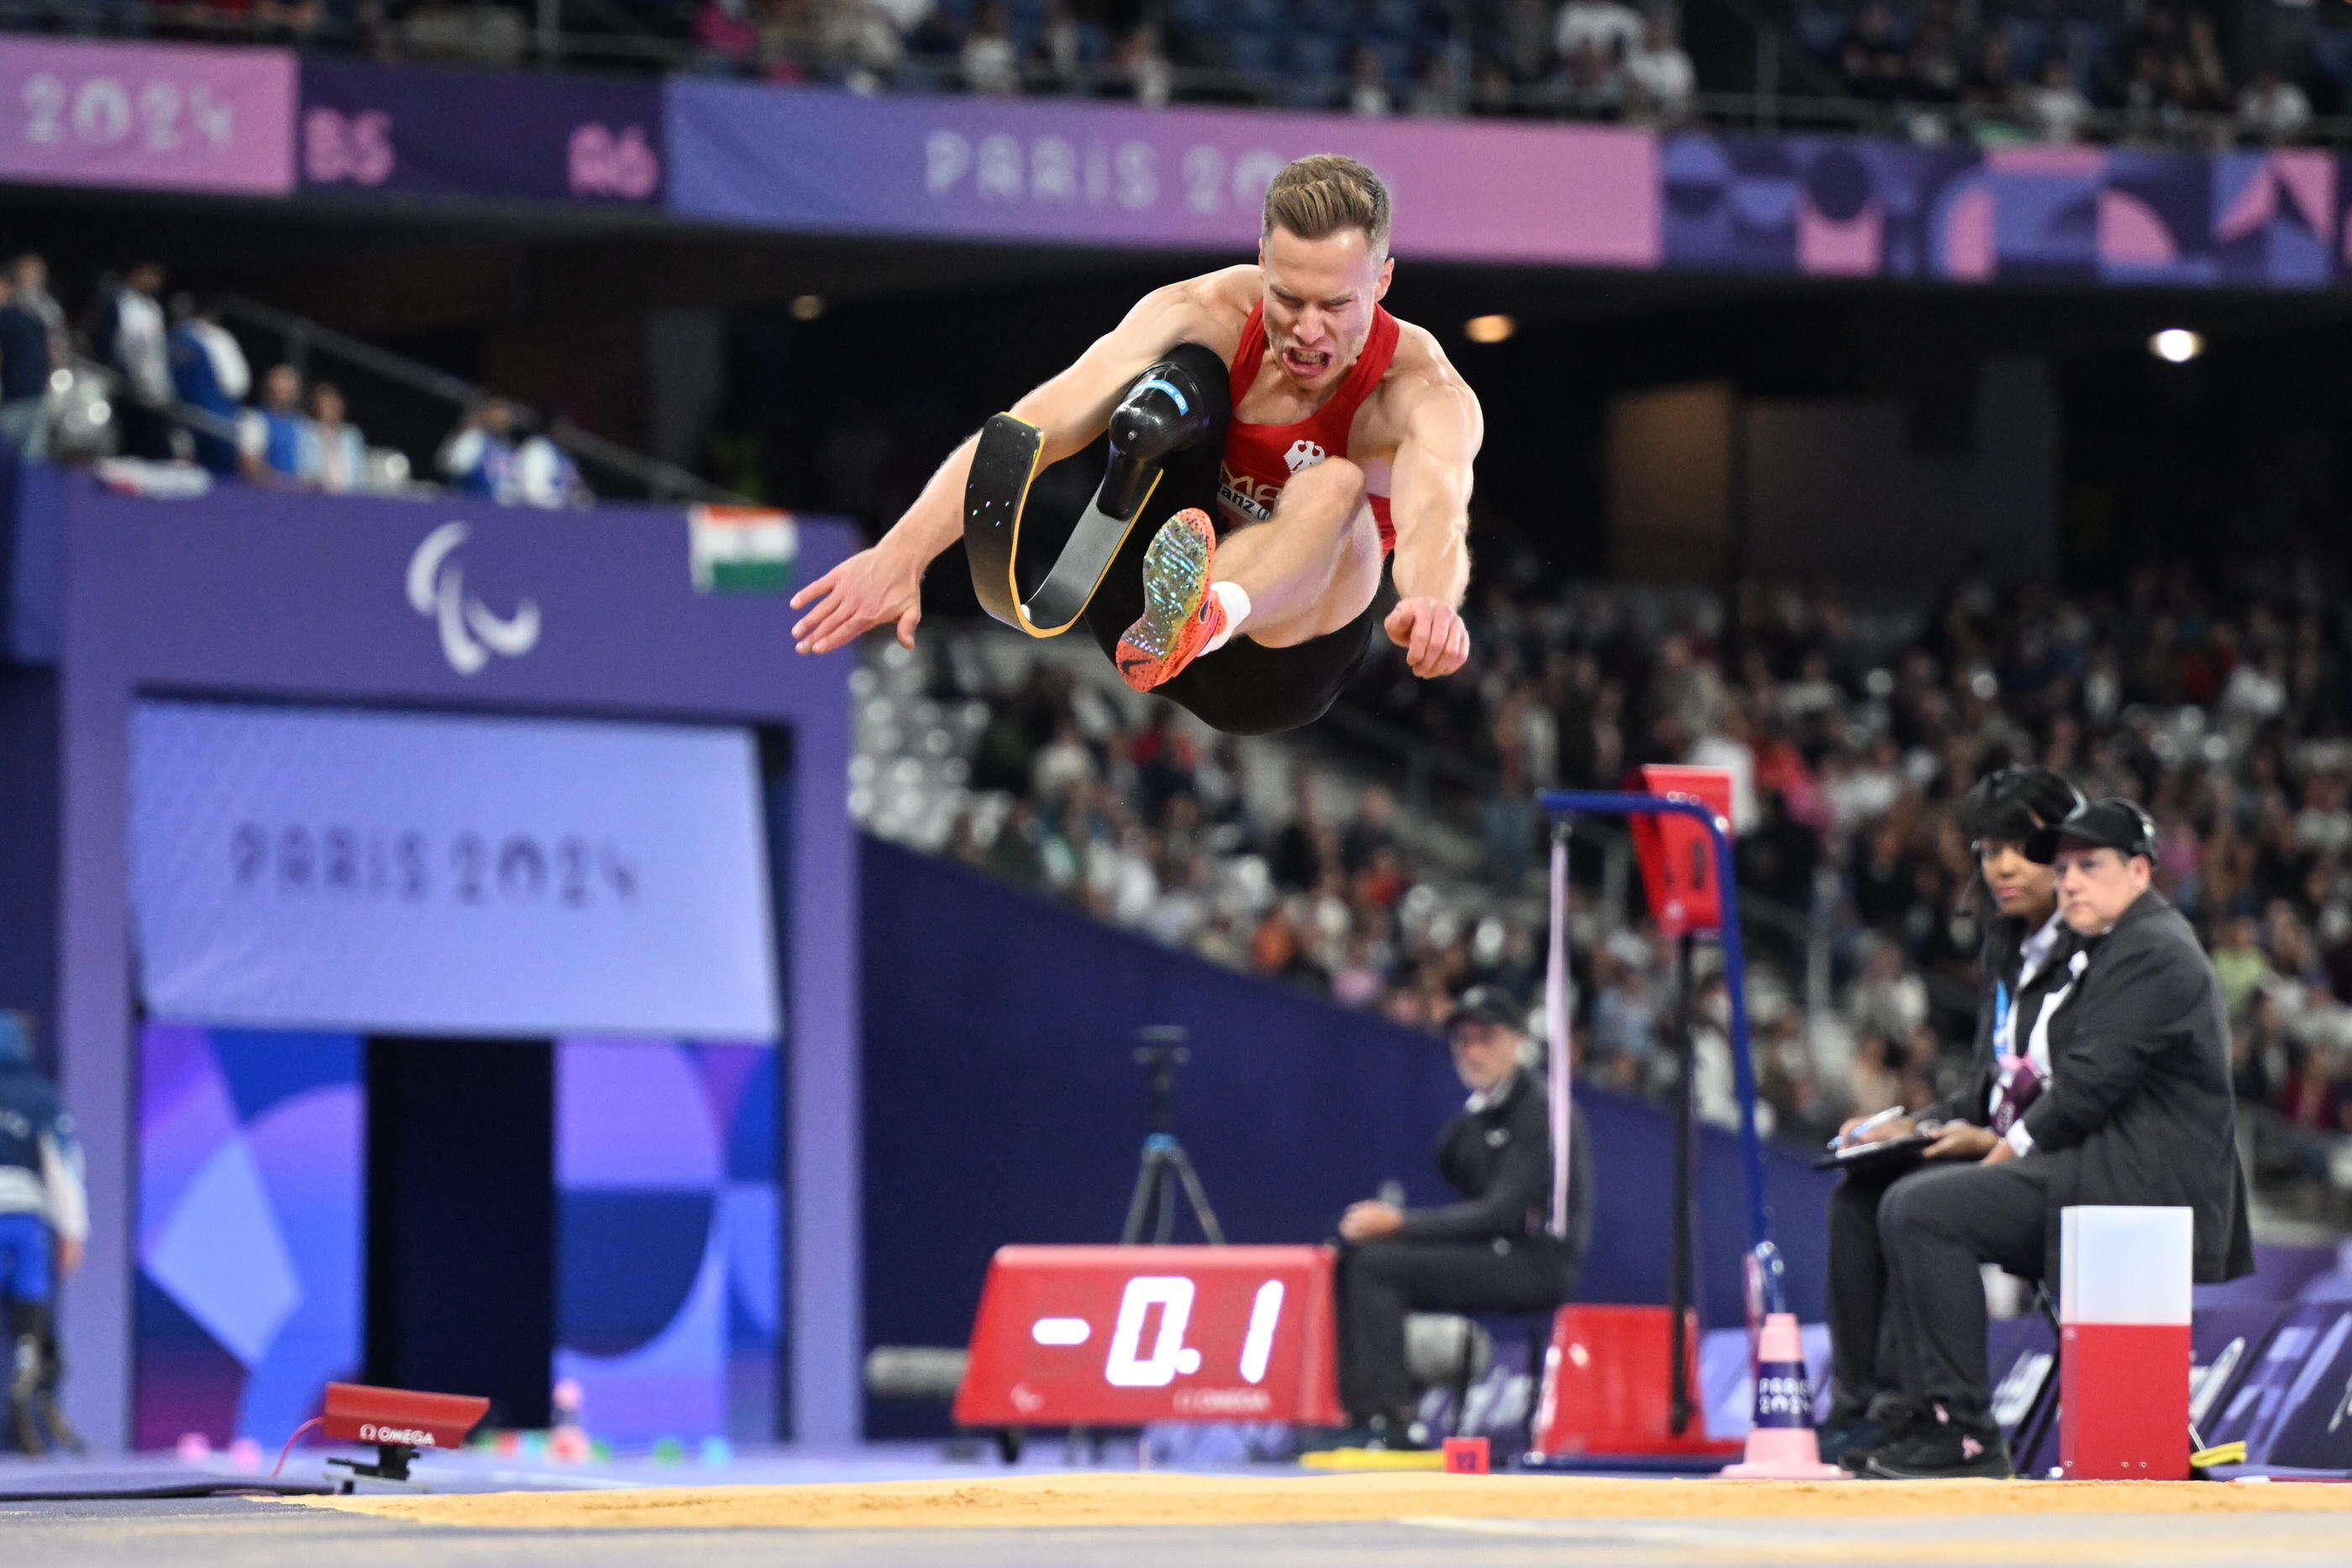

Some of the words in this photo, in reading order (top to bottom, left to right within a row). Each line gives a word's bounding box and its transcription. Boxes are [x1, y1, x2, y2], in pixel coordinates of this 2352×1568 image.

[23, 74, 233, 149] 2024
[926, 130, 1158, 208] PARIS
[1182, 144, 1284, 215] 20
[1221, 486, 1256, 514] anz
[232, 820, 428, 902] PARIS
[450, 832, 638, 910] 2024
[1032, 1277, 1284, 1386] -0.1
[378, 1426, 435, 1445] OMEGA
